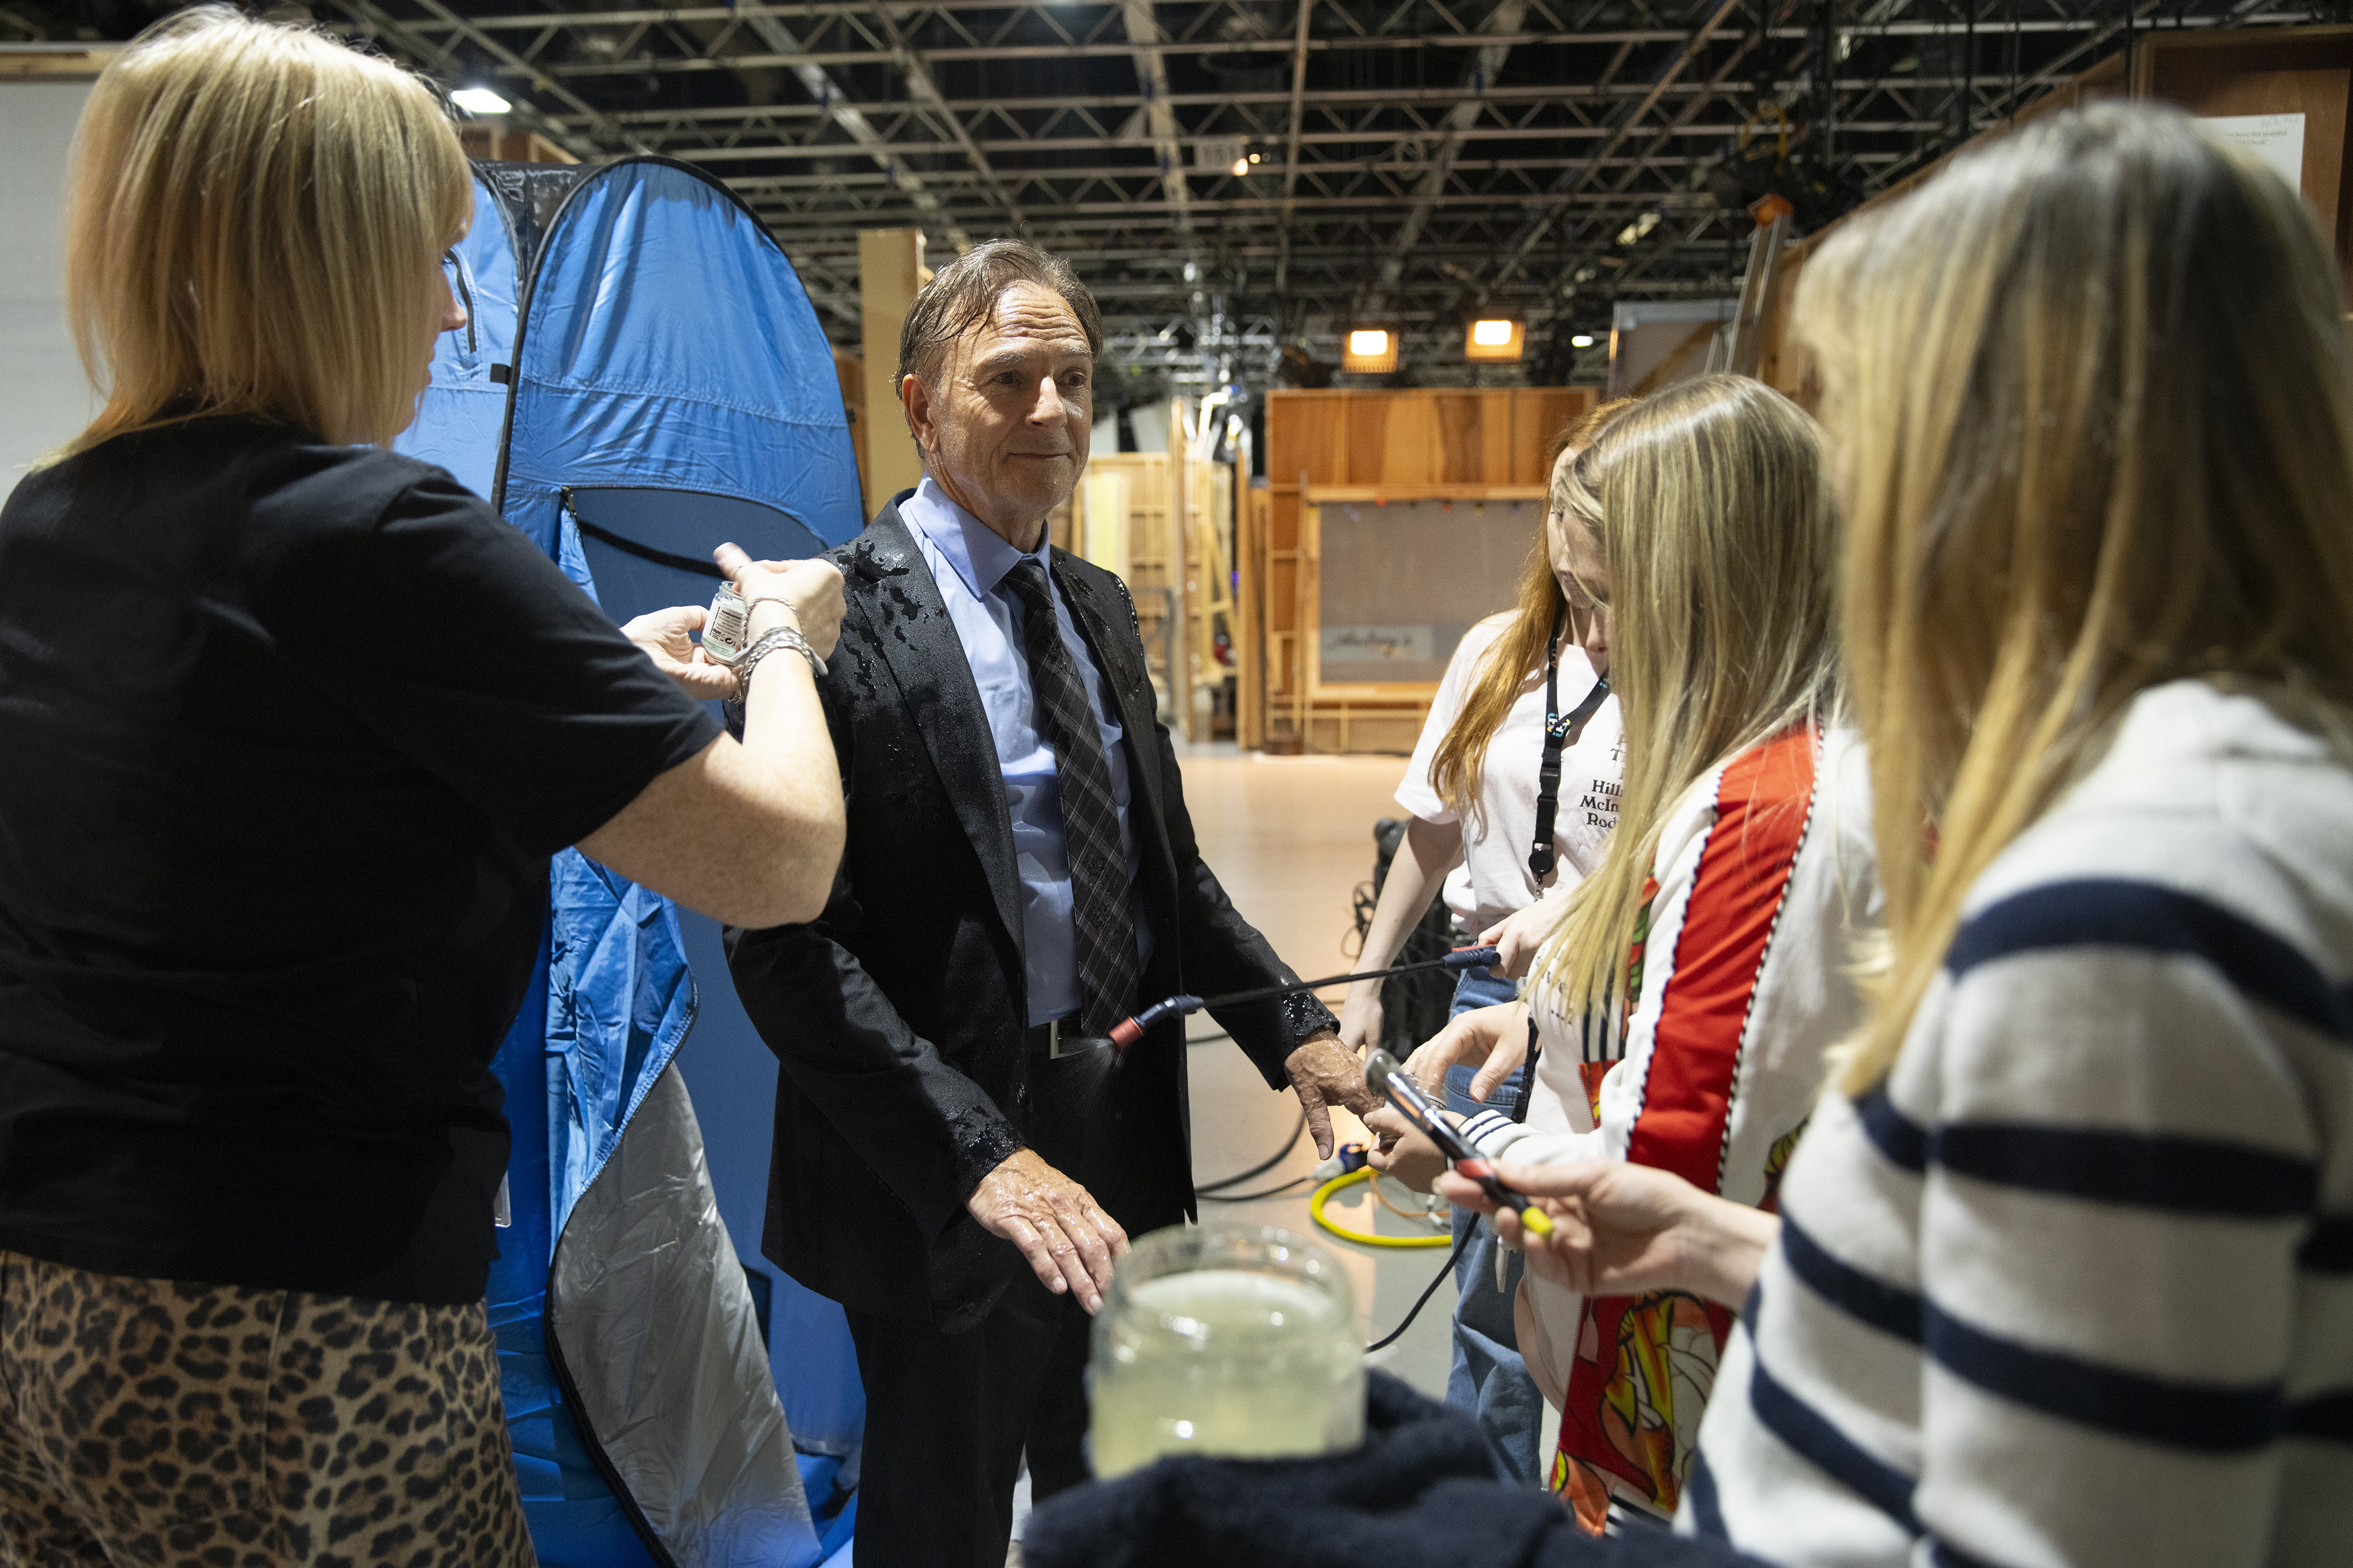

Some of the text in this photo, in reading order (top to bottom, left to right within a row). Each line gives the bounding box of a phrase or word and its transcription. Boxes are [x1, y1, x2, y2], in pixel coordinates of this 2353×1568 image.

[722, 610, 742, 620] Application
[1547, 712, 1558, 732] itv
[1553, 719, 1570, 737] itv
[1580, 795, 1619, 812] McIn
[1587, 812, 1617, 829] Rod
